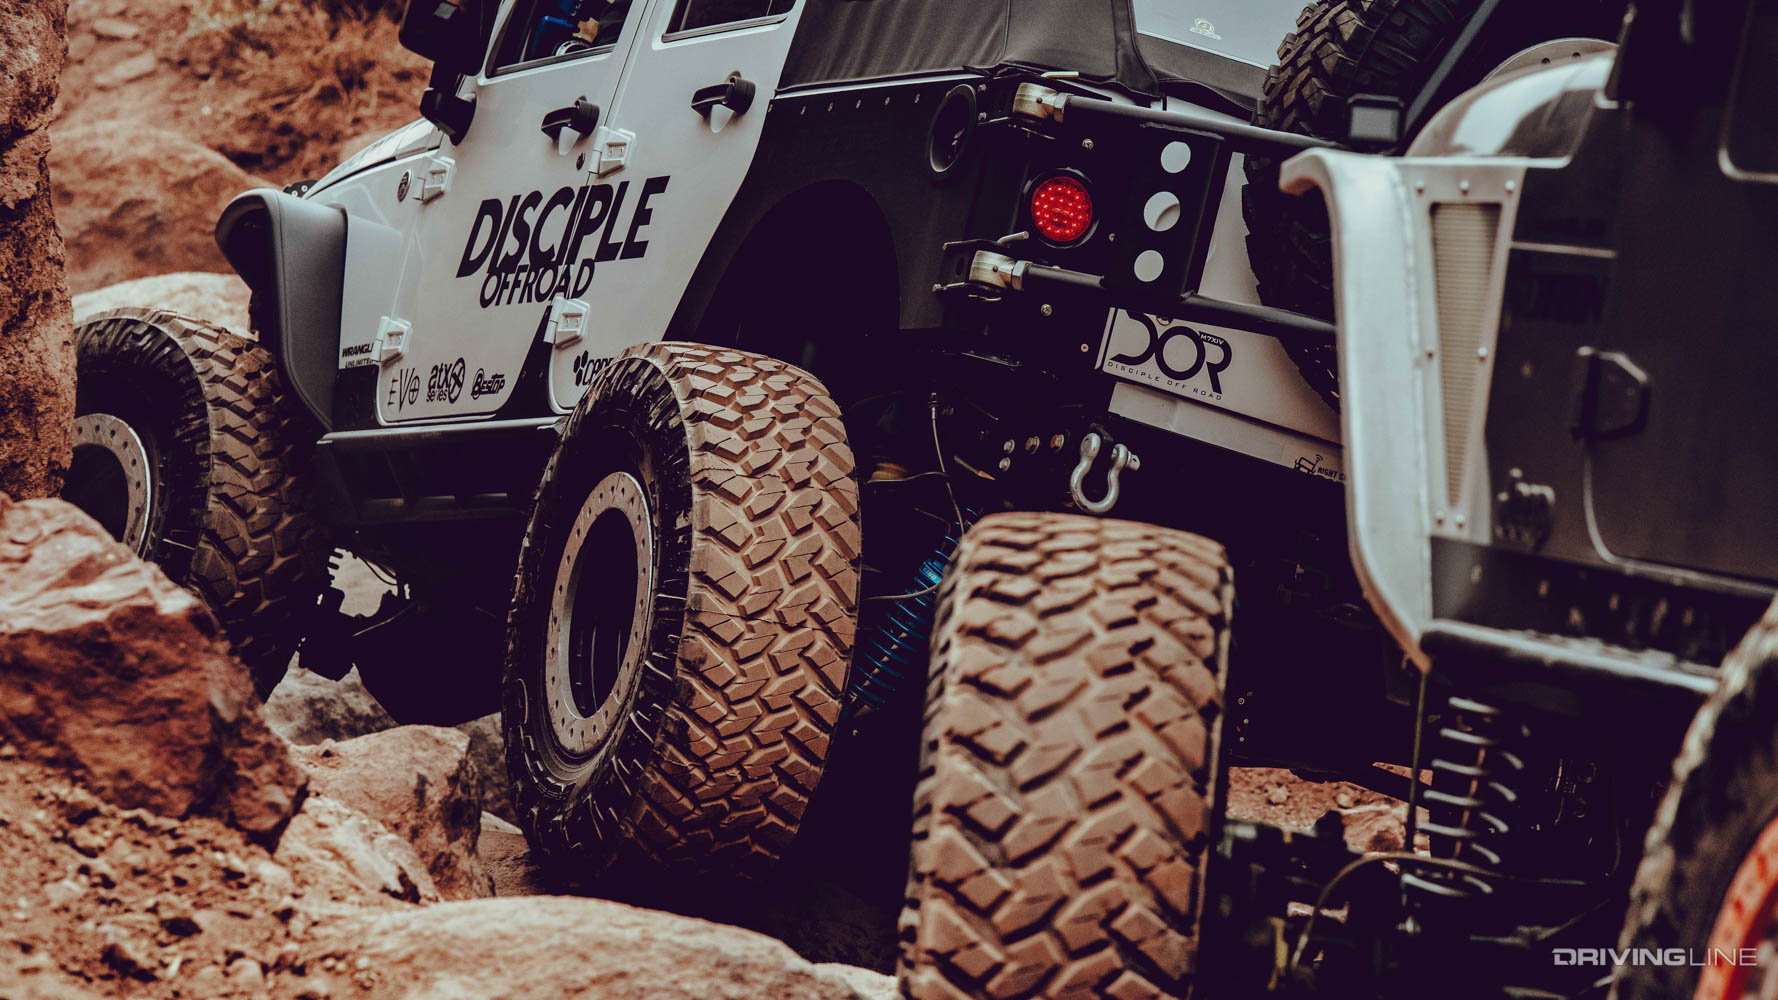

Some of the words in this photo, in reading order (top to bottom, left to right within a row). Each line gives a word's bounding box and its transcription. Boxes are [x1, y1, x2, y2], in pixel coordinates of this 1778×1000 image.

[456, 175, 670, 278] DISCIPLE
[479, 258, 595, 308] OFFROAD
[342, 342, 374, 358] WRANGL
[1109, 309, 1232, 394] DOR
[426, 389, 448, 402] series
[1107, 361, 1160, 382] DISCIPLE
[1166, 379, 1188, 390] OFF
[1192, 388, 1222, 402] ROAD
[1318, 467, 1338, 479] RIGHT
